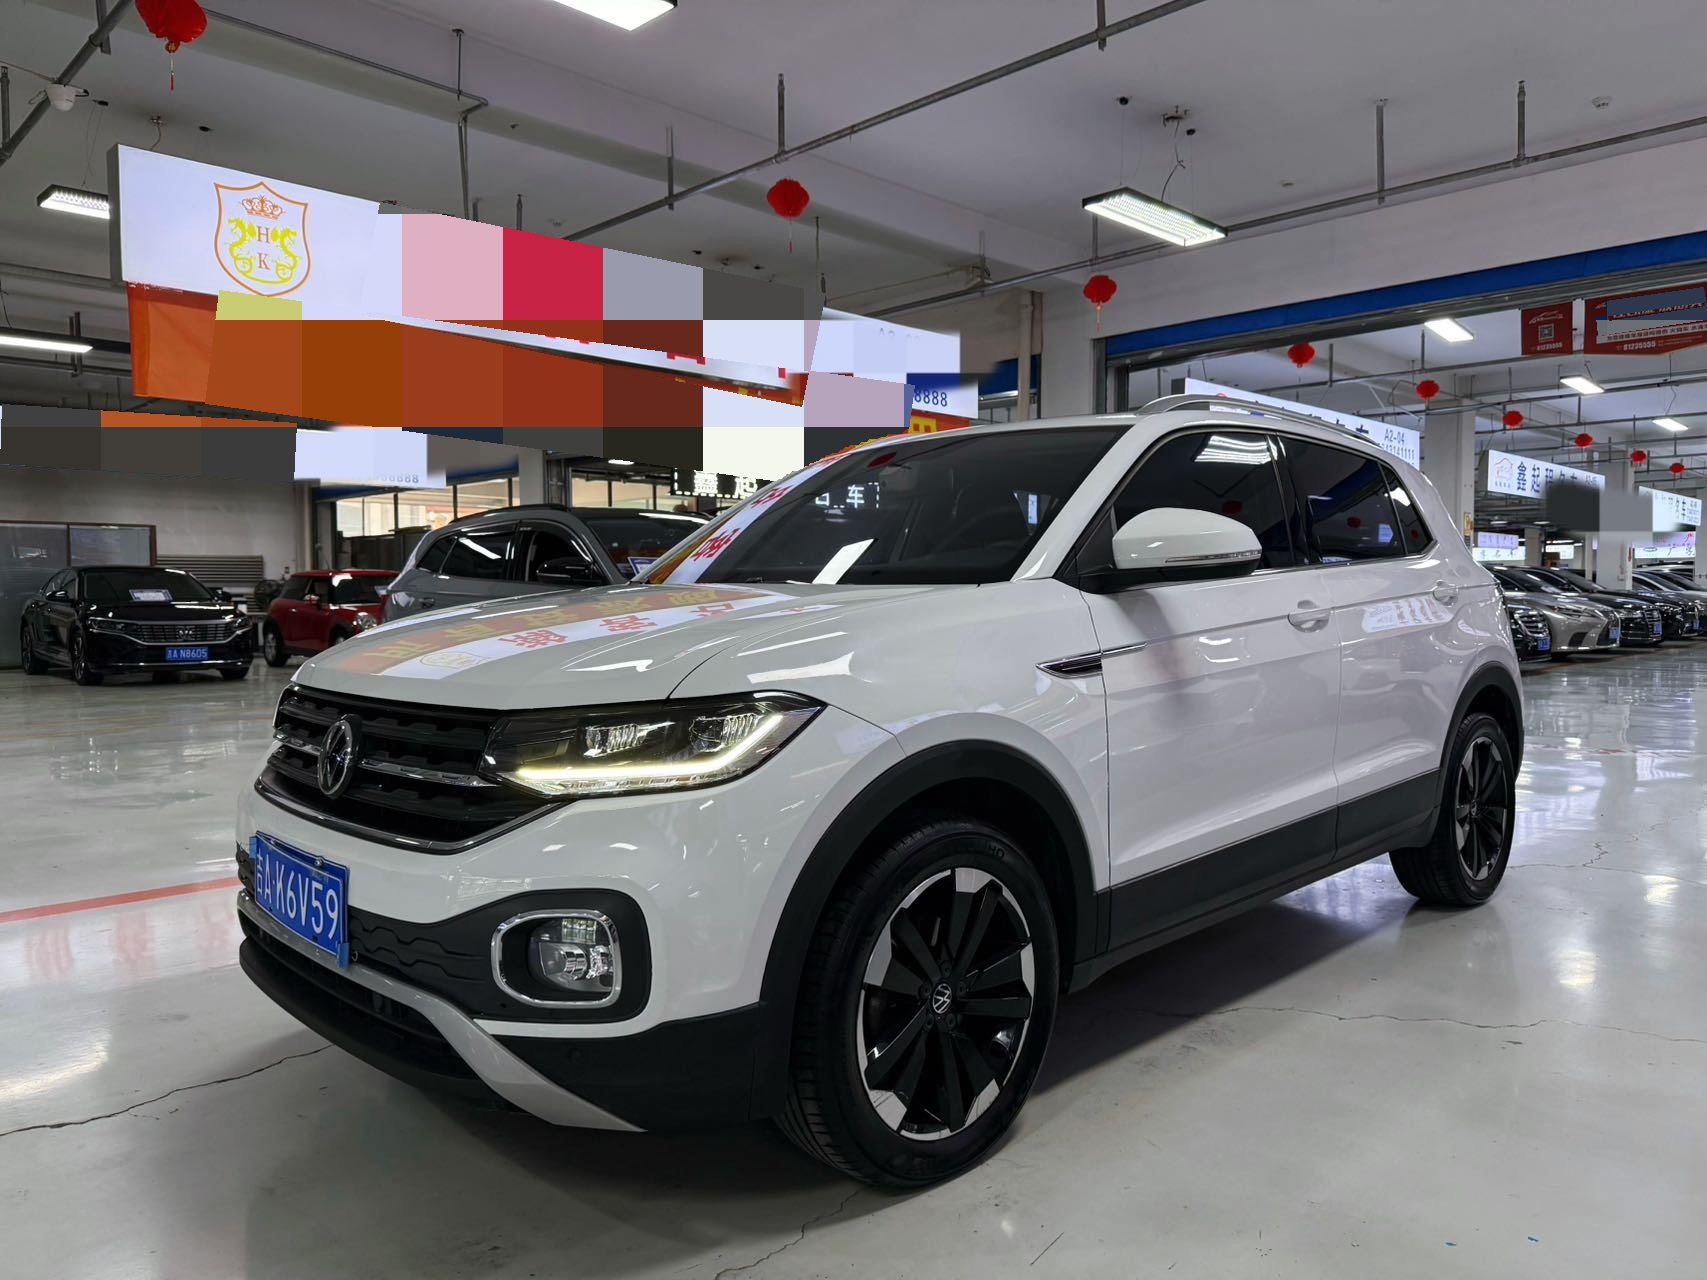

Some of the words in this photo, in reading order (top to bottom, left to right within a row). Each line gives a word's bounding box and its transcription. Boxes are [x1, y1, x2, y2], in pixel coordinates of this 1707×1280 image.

[257, 225, 270, 244] H
[257, 252, 270, 271] K
[1384, 428, 1405, 445] A2-04
